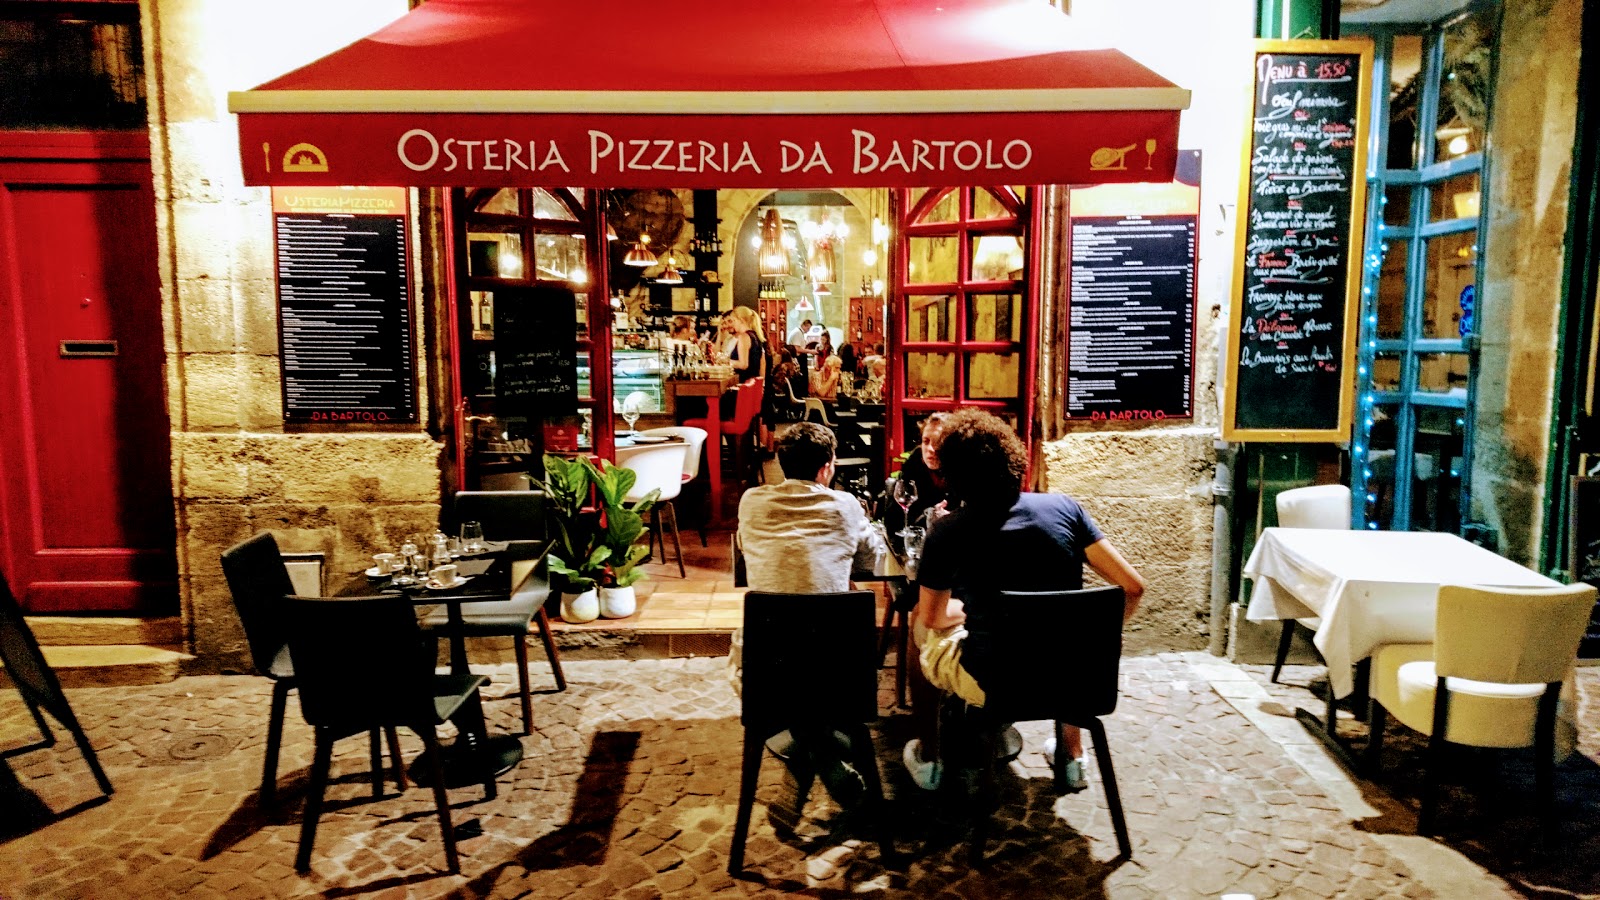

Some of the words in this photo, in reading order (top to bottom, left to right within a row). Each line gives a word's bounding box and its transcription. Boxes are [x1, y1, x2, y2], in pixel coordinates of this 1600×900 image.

[397, 128, 571, 172] OSTERIA
[588, 129, 762, 174] PIZZERIA
[780, 139, 833, 174] DA
[852, 128, 1032, 174] BARTOLO
[312, 411, 328, 420] DA
[331, 411, 387, 420] BARTOLO
[1091, 410, 1107, 420] DA
[1109, 409, 1165, 420] BARTOLO
